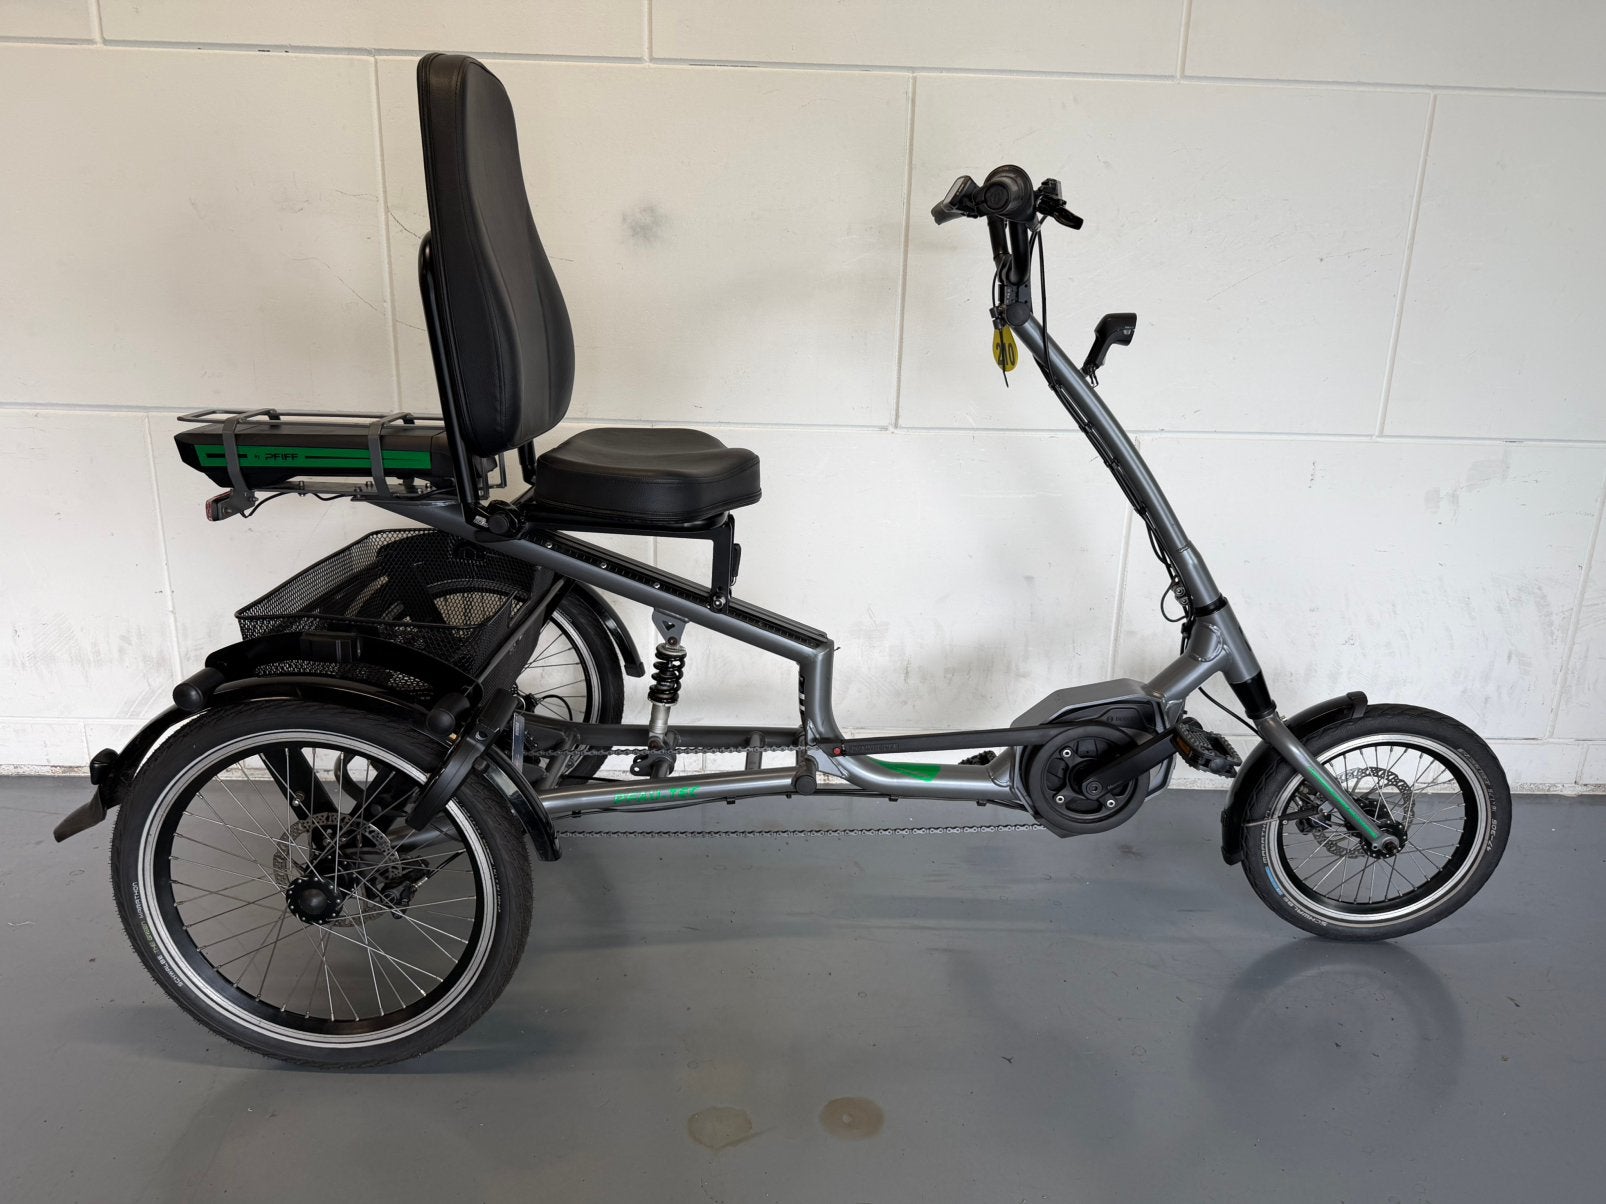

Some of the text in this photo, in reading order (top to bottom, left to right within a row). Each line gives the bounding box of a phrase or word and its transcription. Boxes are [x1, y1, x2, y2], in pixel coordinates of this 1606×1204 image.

[265, 453, 299, 461] PFIFF
[132, 881, 145, 919] MARATHON
[157, 954, 184, 987] SCHWALBE
